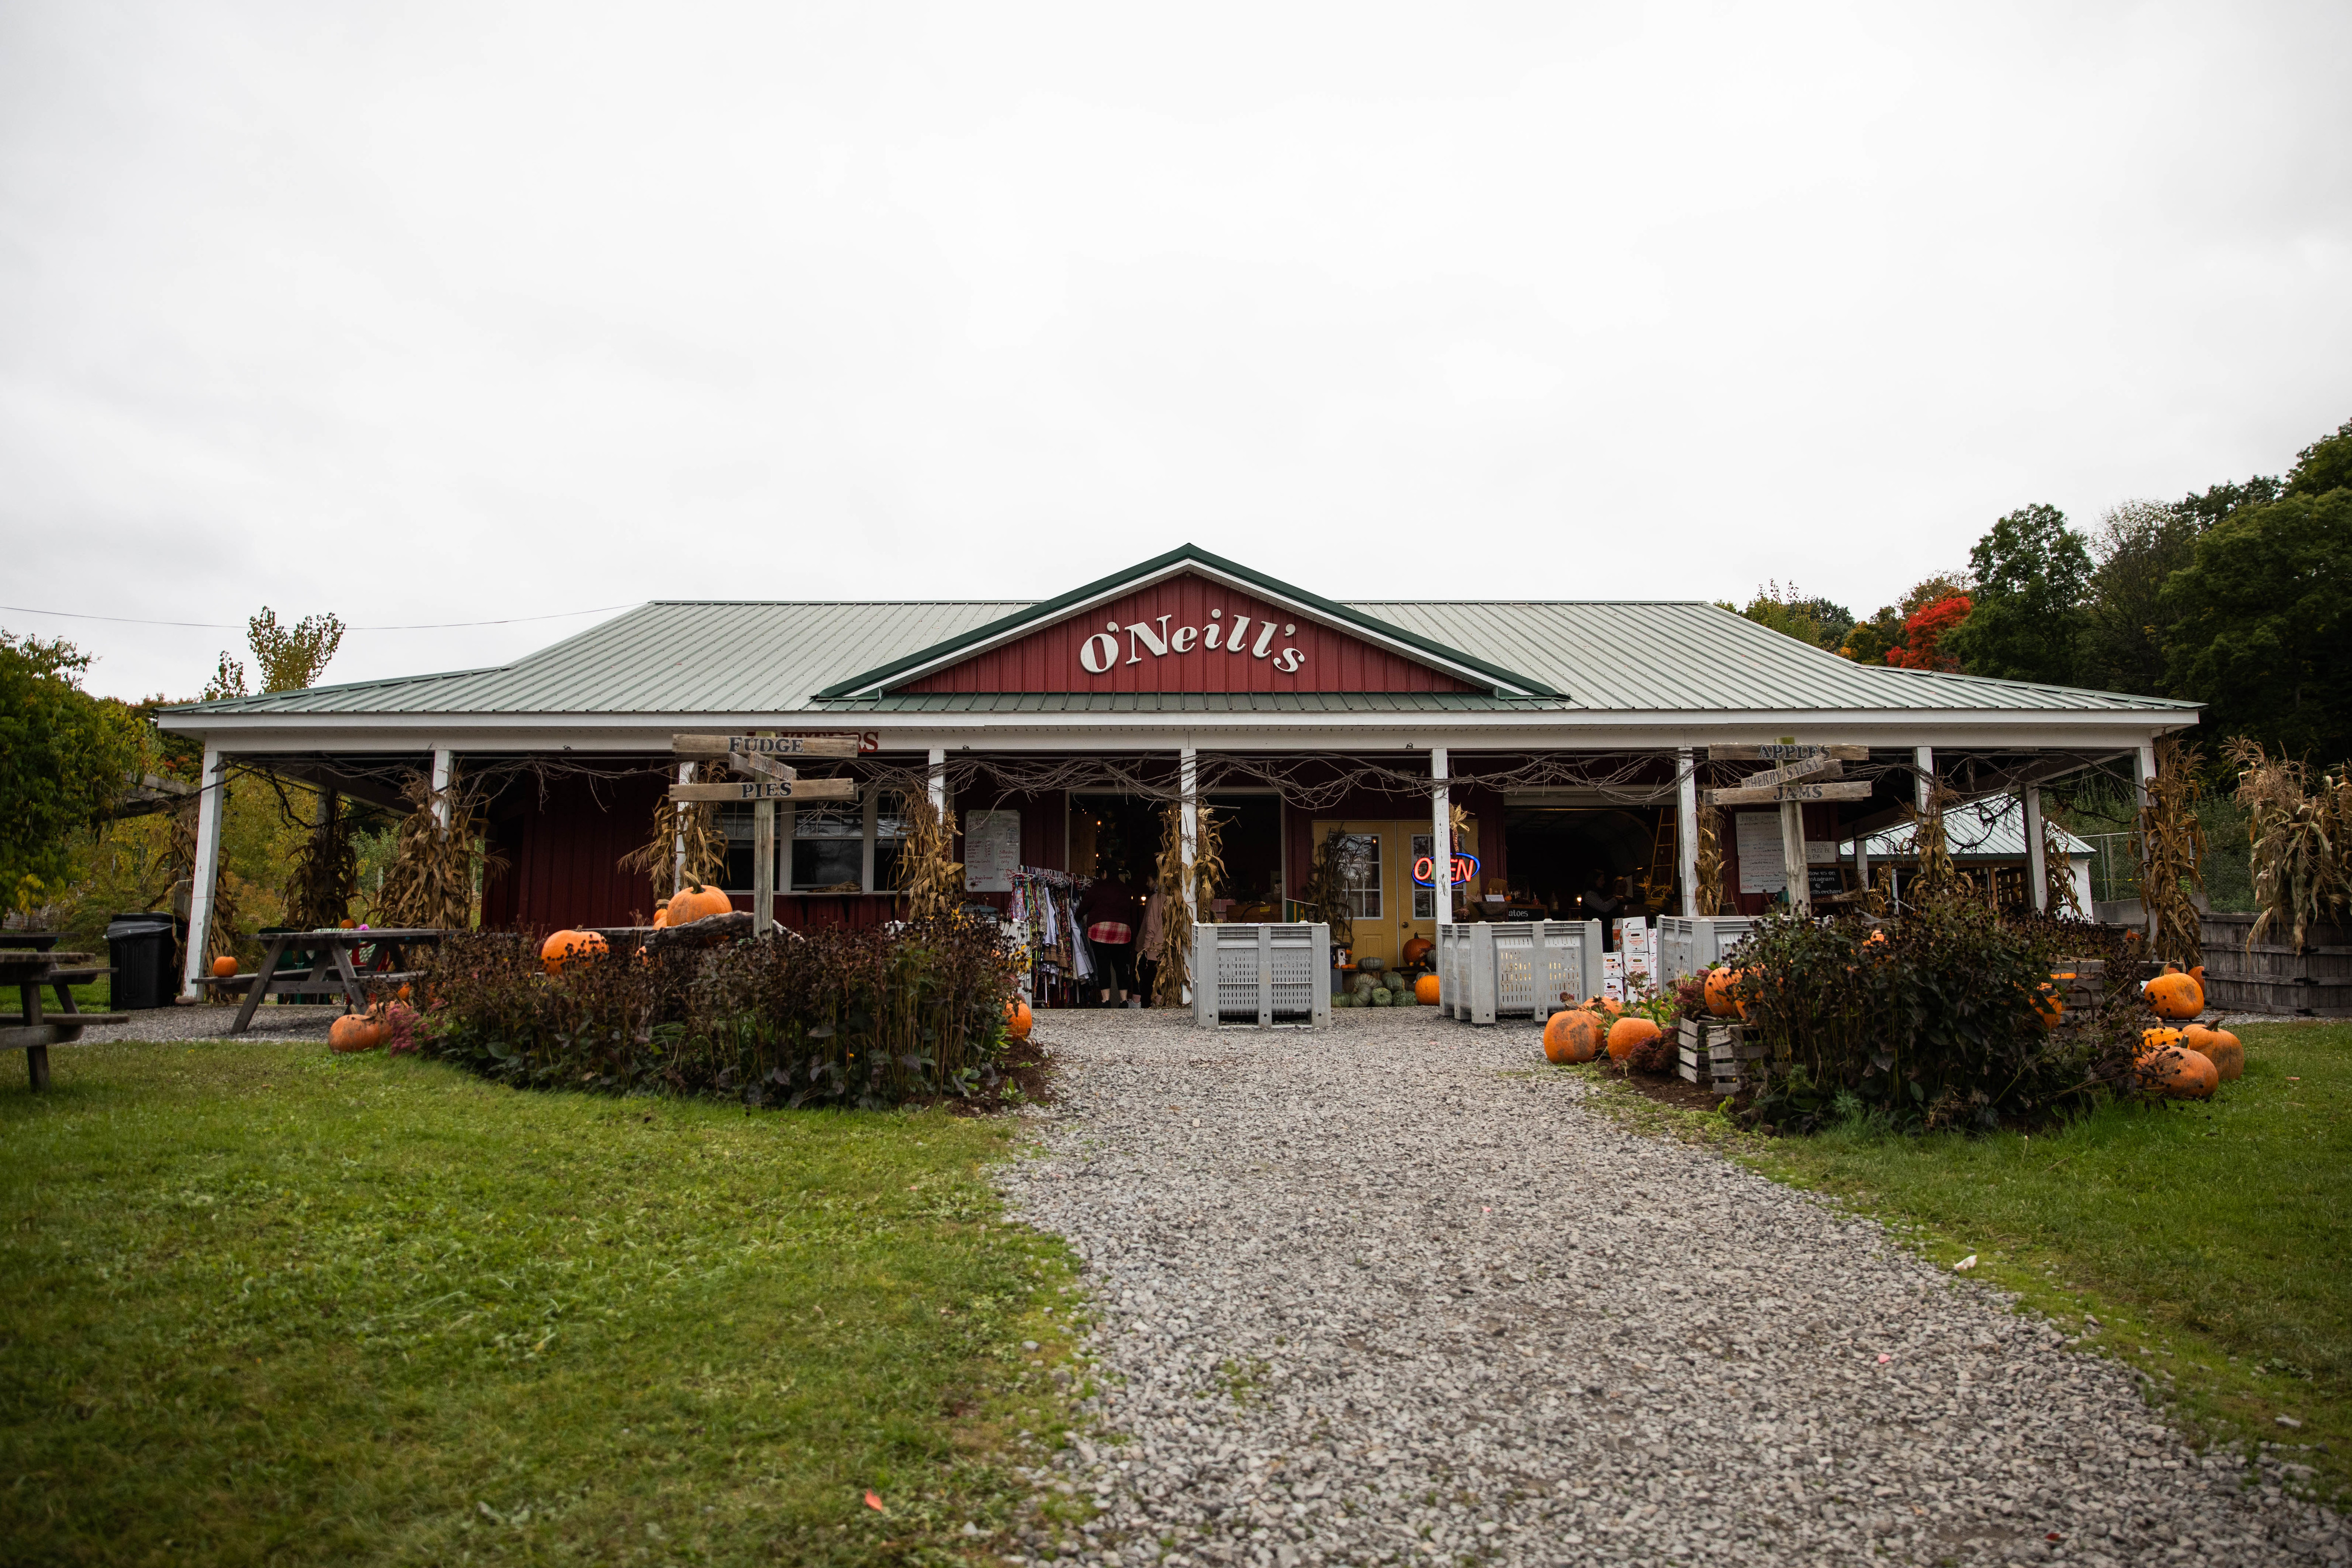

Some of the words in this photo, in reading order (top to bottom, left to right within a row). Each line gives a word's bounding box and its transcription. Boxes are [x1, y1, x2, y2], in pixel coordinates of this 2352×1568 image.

[1080, 608, 1305, 673] O'Neill's
[728, 736, 804, 753] FUDGE
[1757, 744, 1831, 759] APPLES
[1745, 770, 1782, 788] CHERRY
[1786, 759, 1819, 780] SALSA
[741, 781, 793, 798] PIES
[1773, 785, 1822, 800] JAMS
[1414, 857, 1474, 882] OEN
